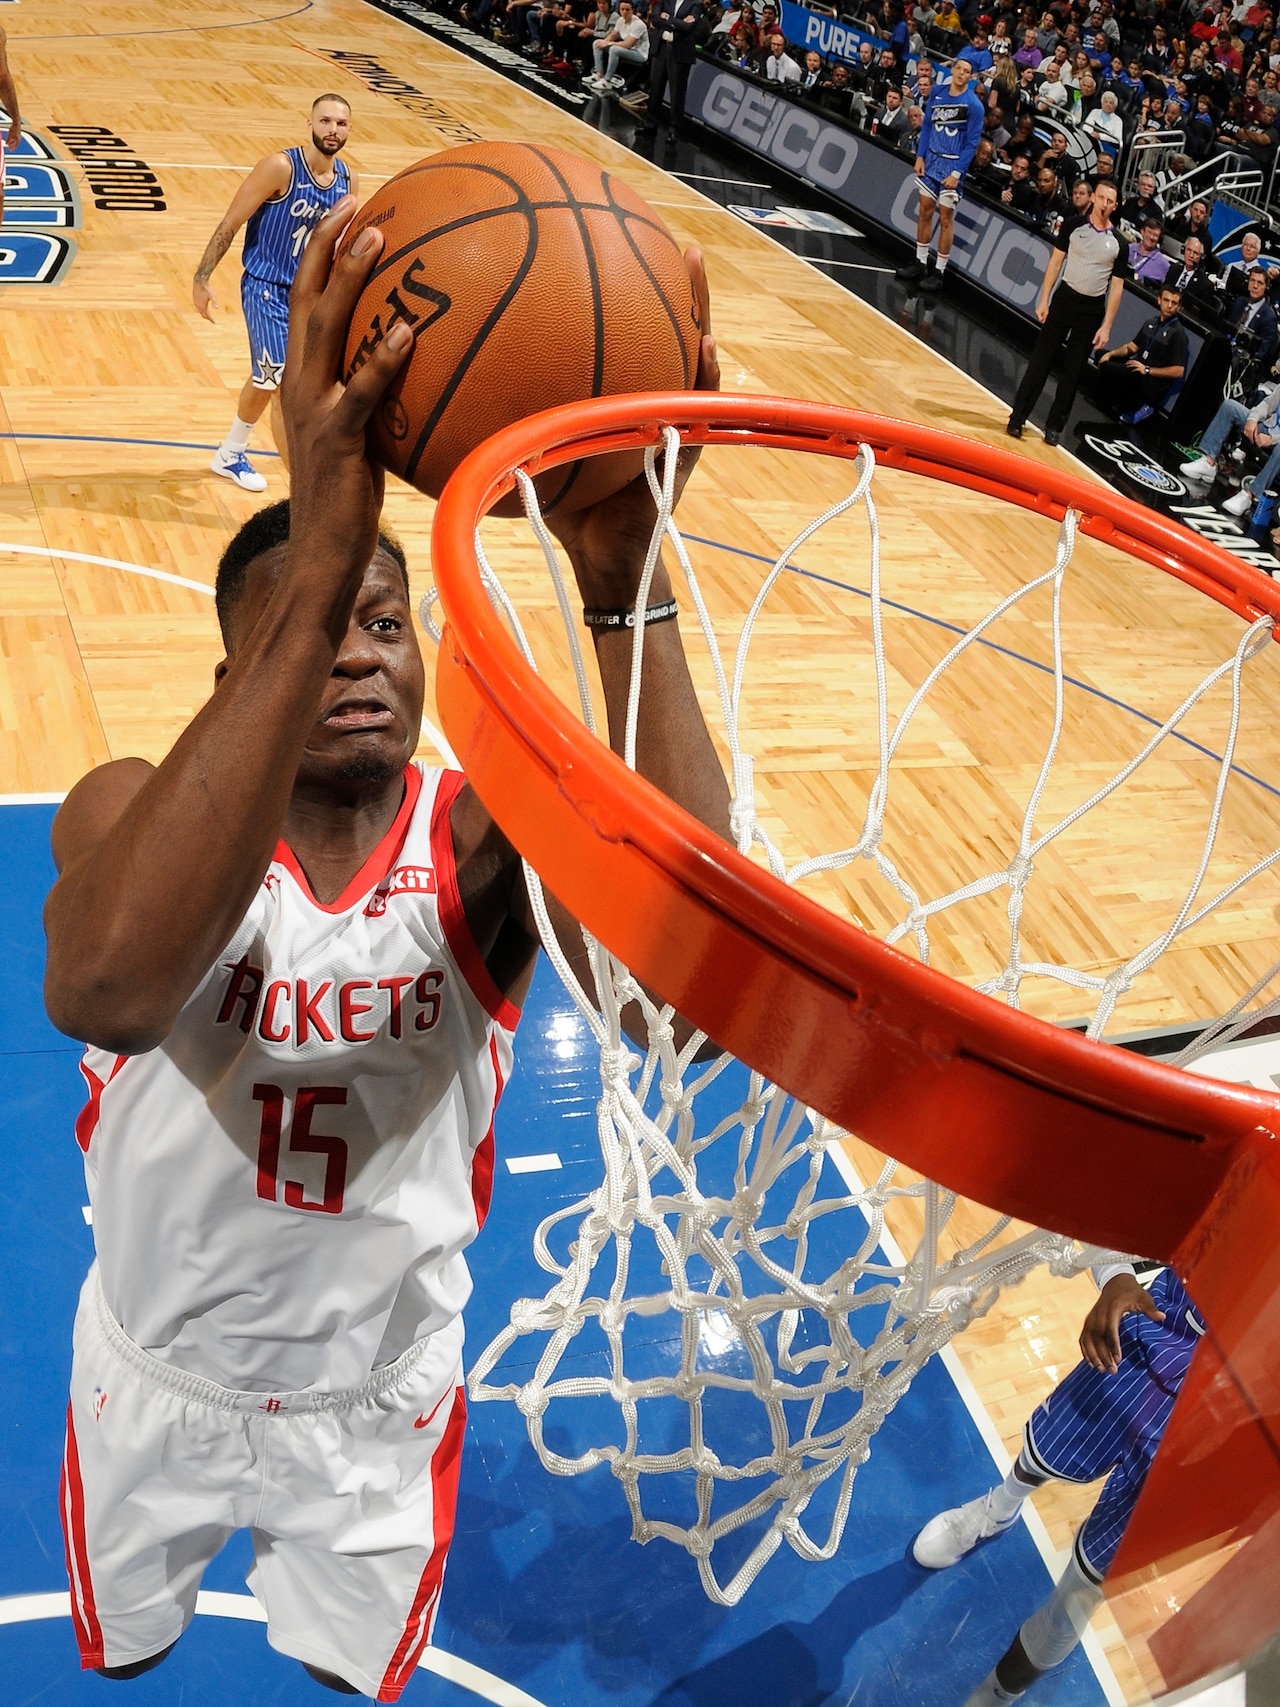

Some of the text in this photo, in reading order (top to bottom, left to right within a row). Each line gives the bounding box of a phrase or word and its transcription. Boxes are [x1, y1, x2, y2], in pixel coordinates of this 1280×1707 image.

[805, 16, 861, 64] PURE
[46, 126, 167, 211] ORLANDO
[702, 73, 858, 190] GEICO
[890, 173, 1060, 310] GEIC
[1169, 505, 1280, 581] YEAR
[216, 954, 445, 1048] RCKETS
[252, 1082, 349, 1214] 15
